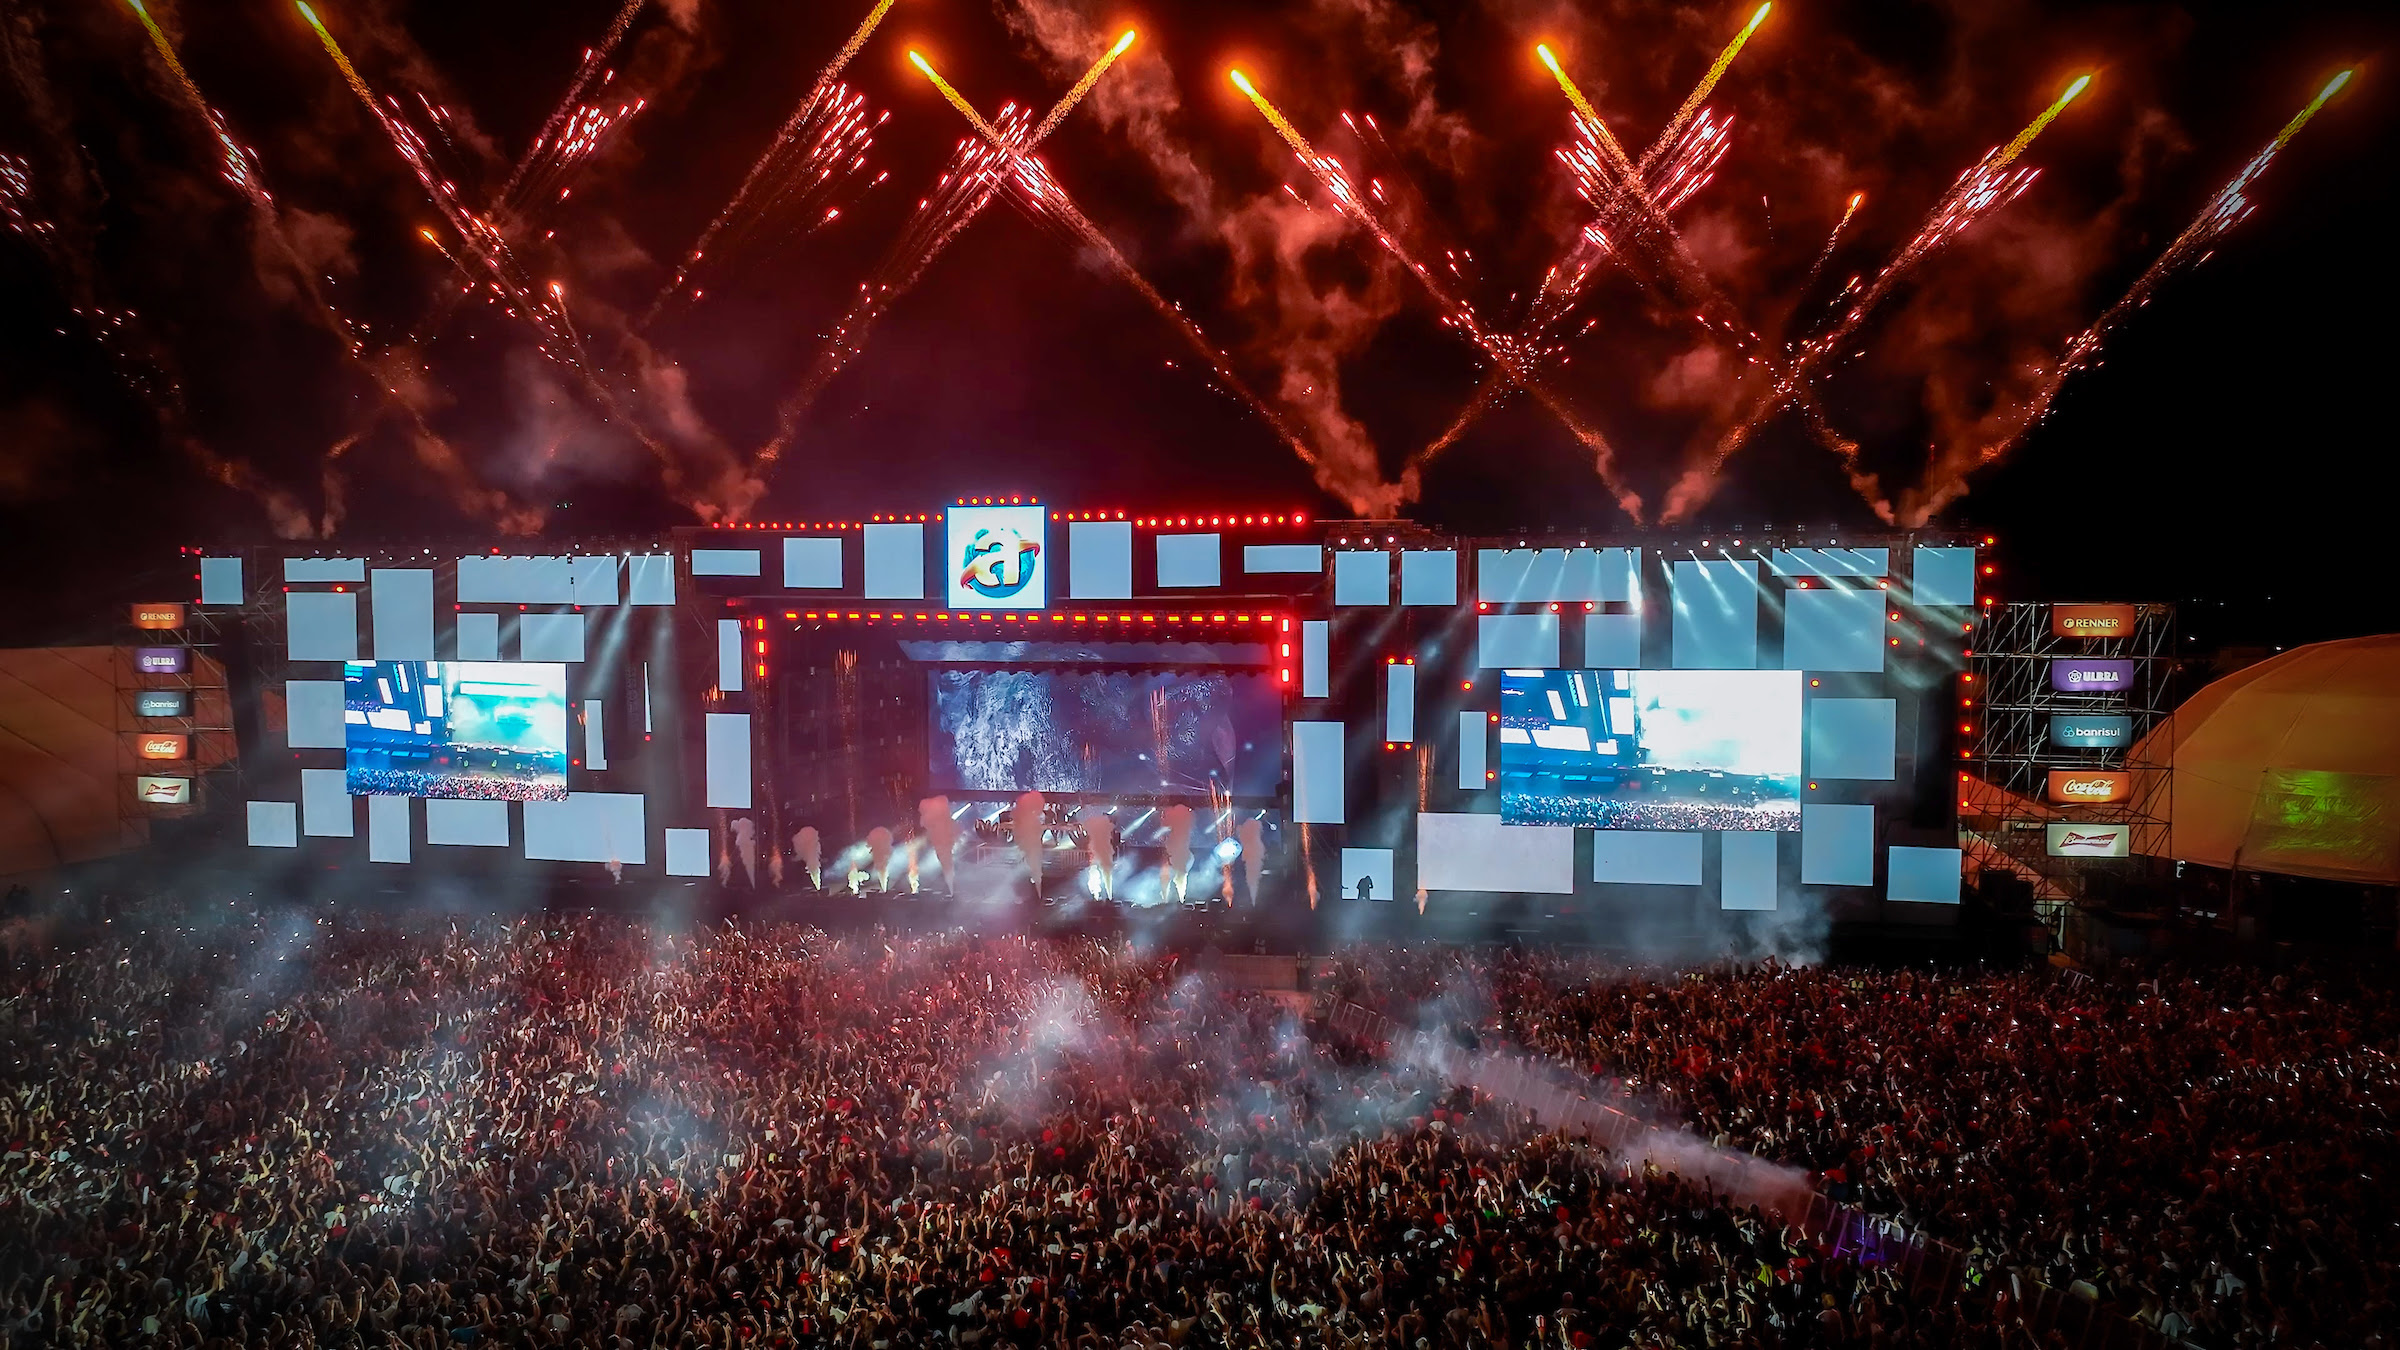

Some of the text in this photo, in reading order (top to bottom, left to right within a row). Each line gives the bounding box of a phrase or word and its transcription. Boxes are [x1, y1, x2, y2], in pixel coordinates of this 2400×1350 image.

[2075, 618, 2119, 628] RENNER
[2082, 671, 2119, 682] ULBRA
[2075, 727, 2120, 737] banrisul
